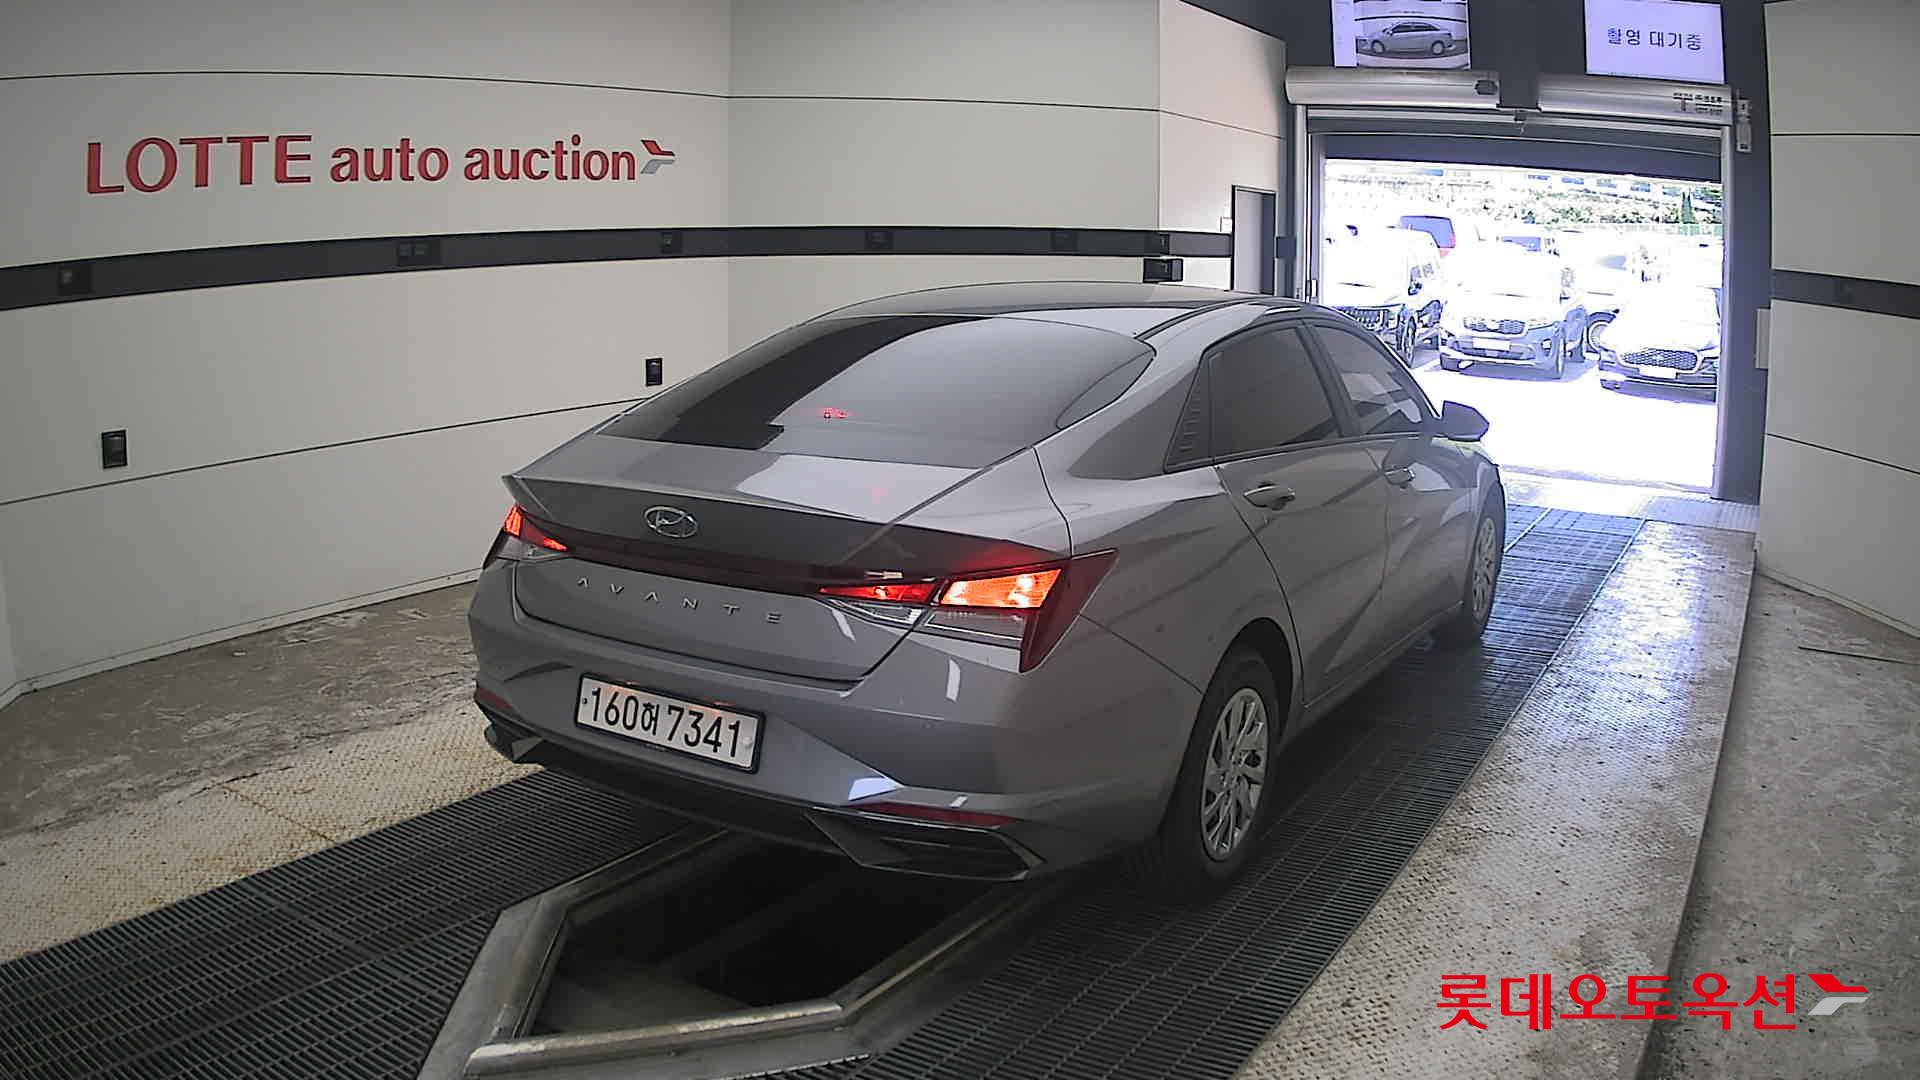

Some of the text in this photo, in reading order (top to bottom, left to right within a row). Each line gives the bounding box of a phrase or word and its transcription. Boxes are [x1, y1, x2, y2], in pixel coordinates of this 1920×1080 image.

[87, 134, 637, 194] LOTTE auto auction
[577, 576, 783, 625] AVANTE
